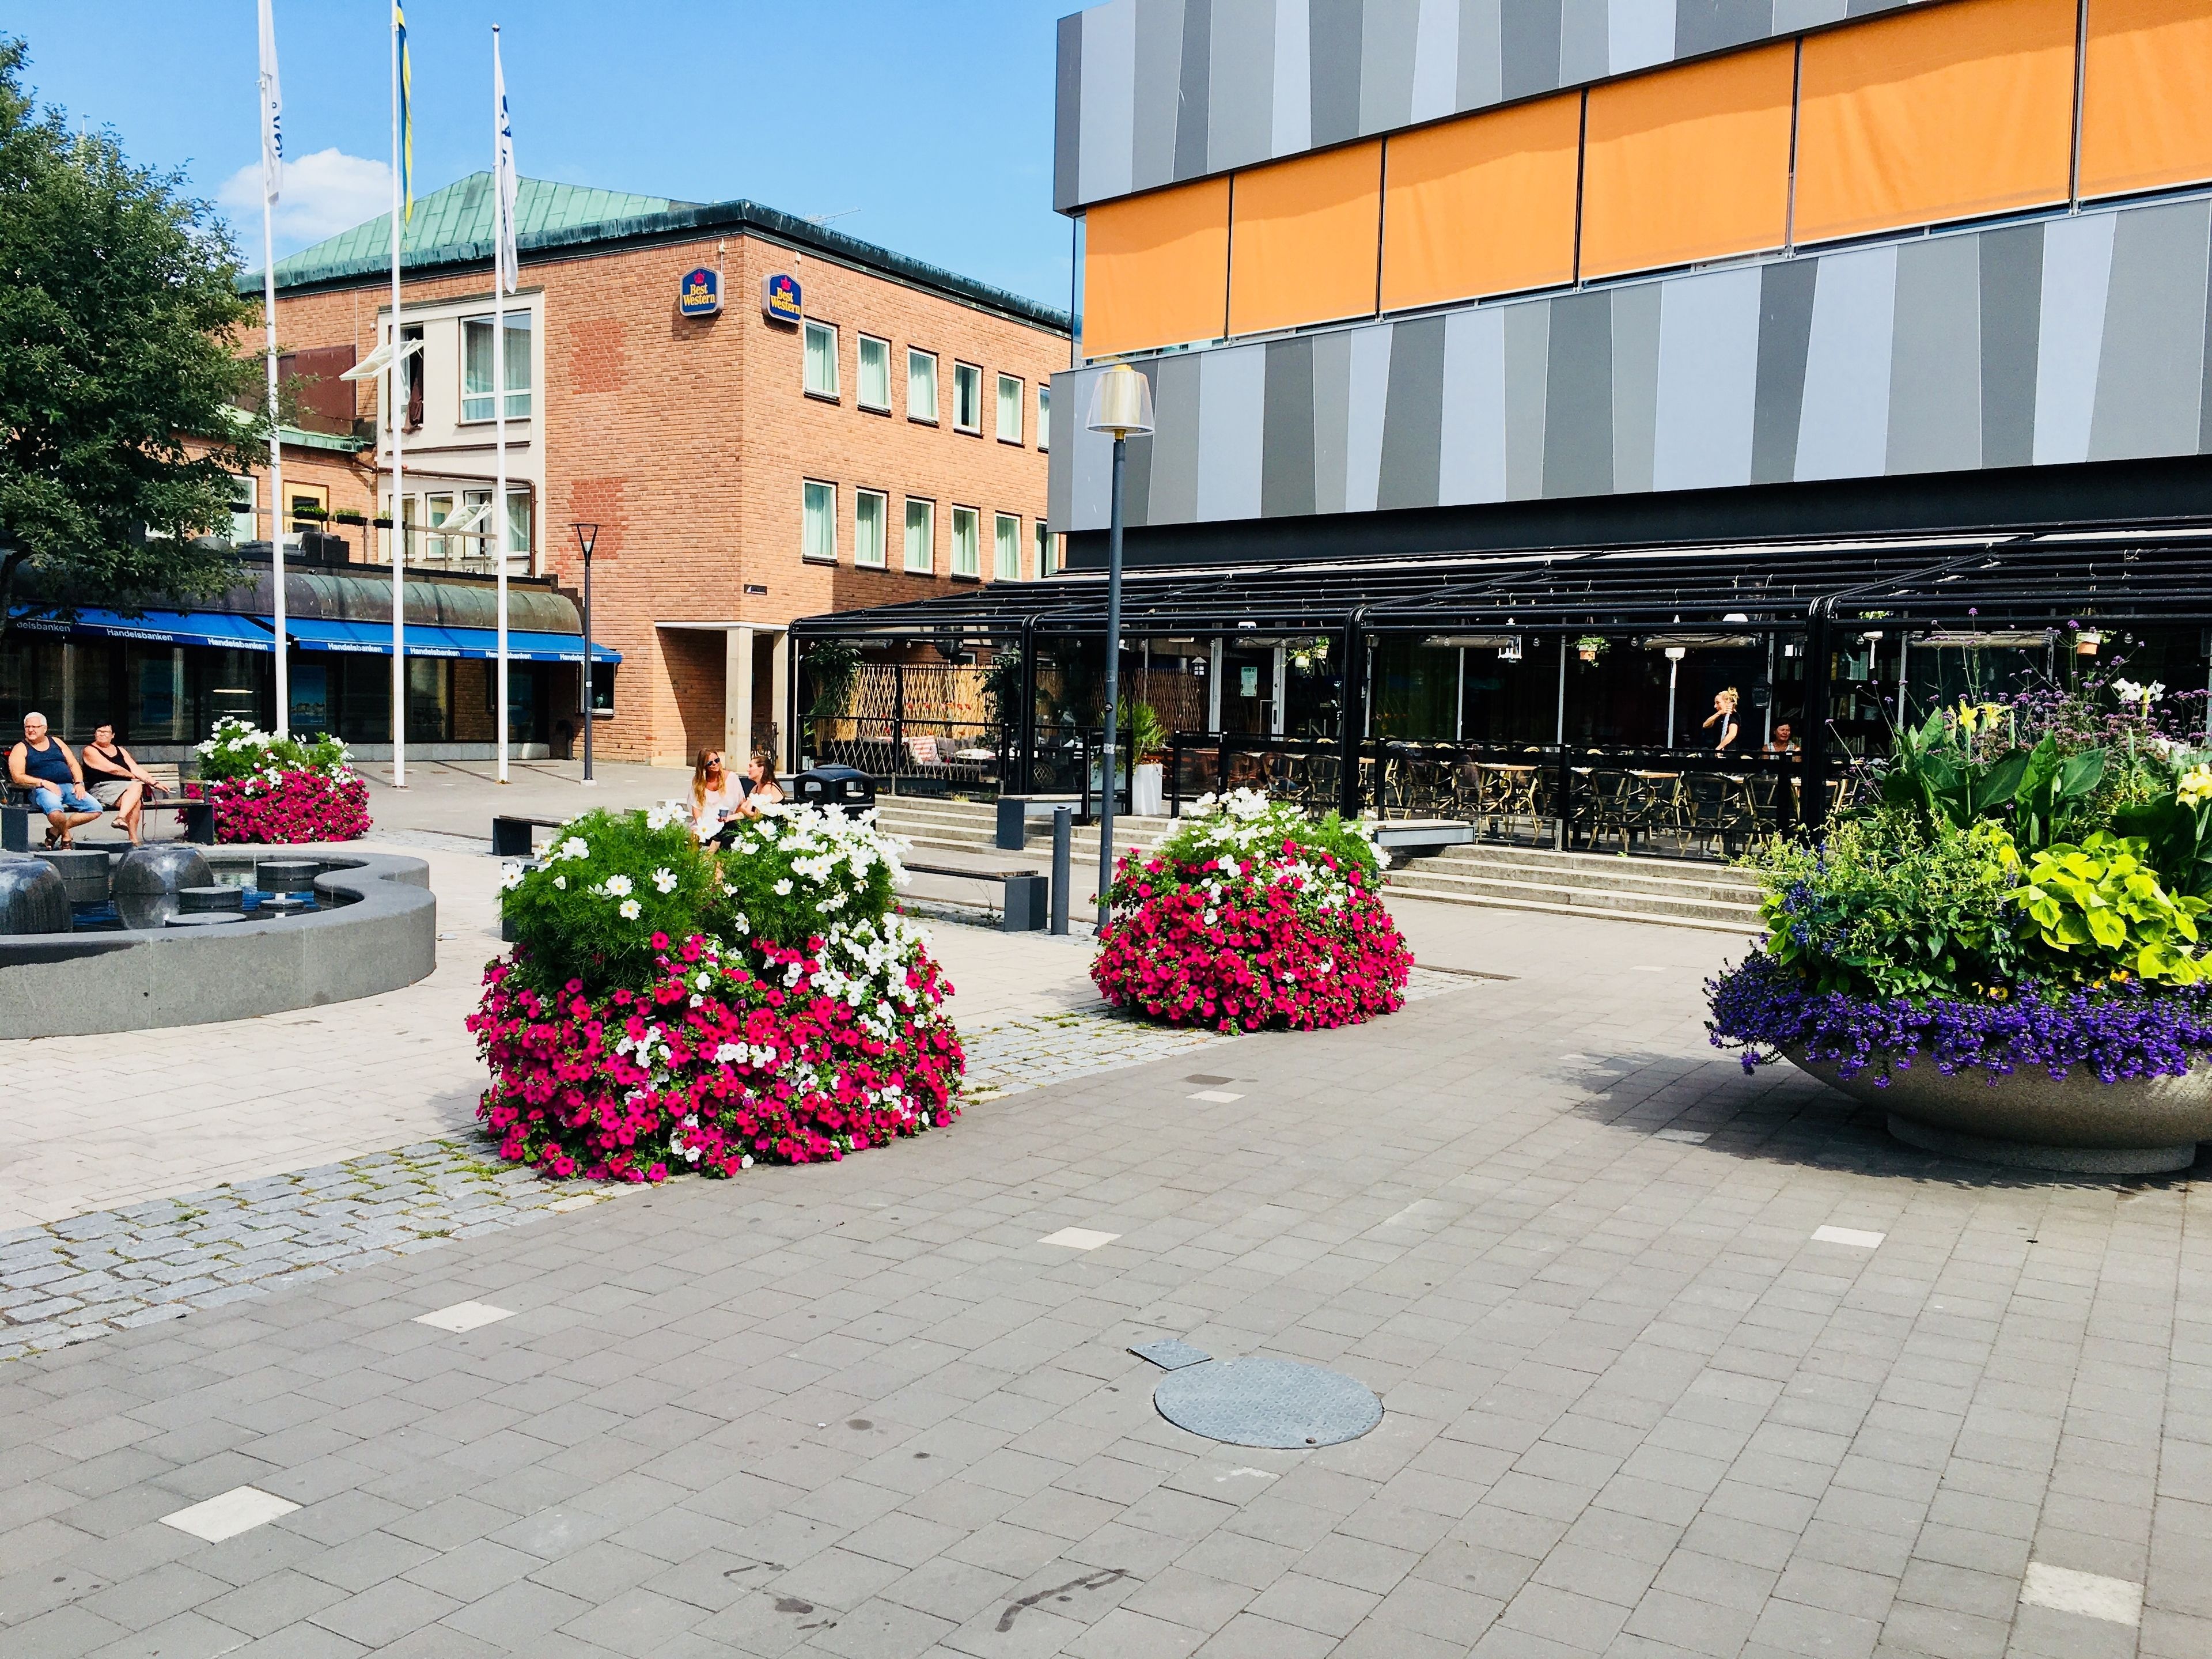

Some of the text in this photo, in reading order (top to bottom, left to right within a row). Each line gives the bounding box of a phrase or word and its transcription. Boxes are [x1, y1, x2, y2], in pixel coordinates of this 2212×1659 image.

[690, 283, 708, 296] Best
[777, 287, 794, 302] Best
[683, 294, 715, 306] Western
[770, 295, 800, 315] Western
[16, 622, 71, 632] delsbanken
[107, 628, 173, 641] Handelsbanken
[207, 638, 268, 651] Handelsbanken
[327, 643, 383, 653] Handelsbanken
[410, 647, 460, 657] Handelsbanken
[486, 650, 532, 660] Hansbanken
[559, 653, 603, 662] Handelsbken
